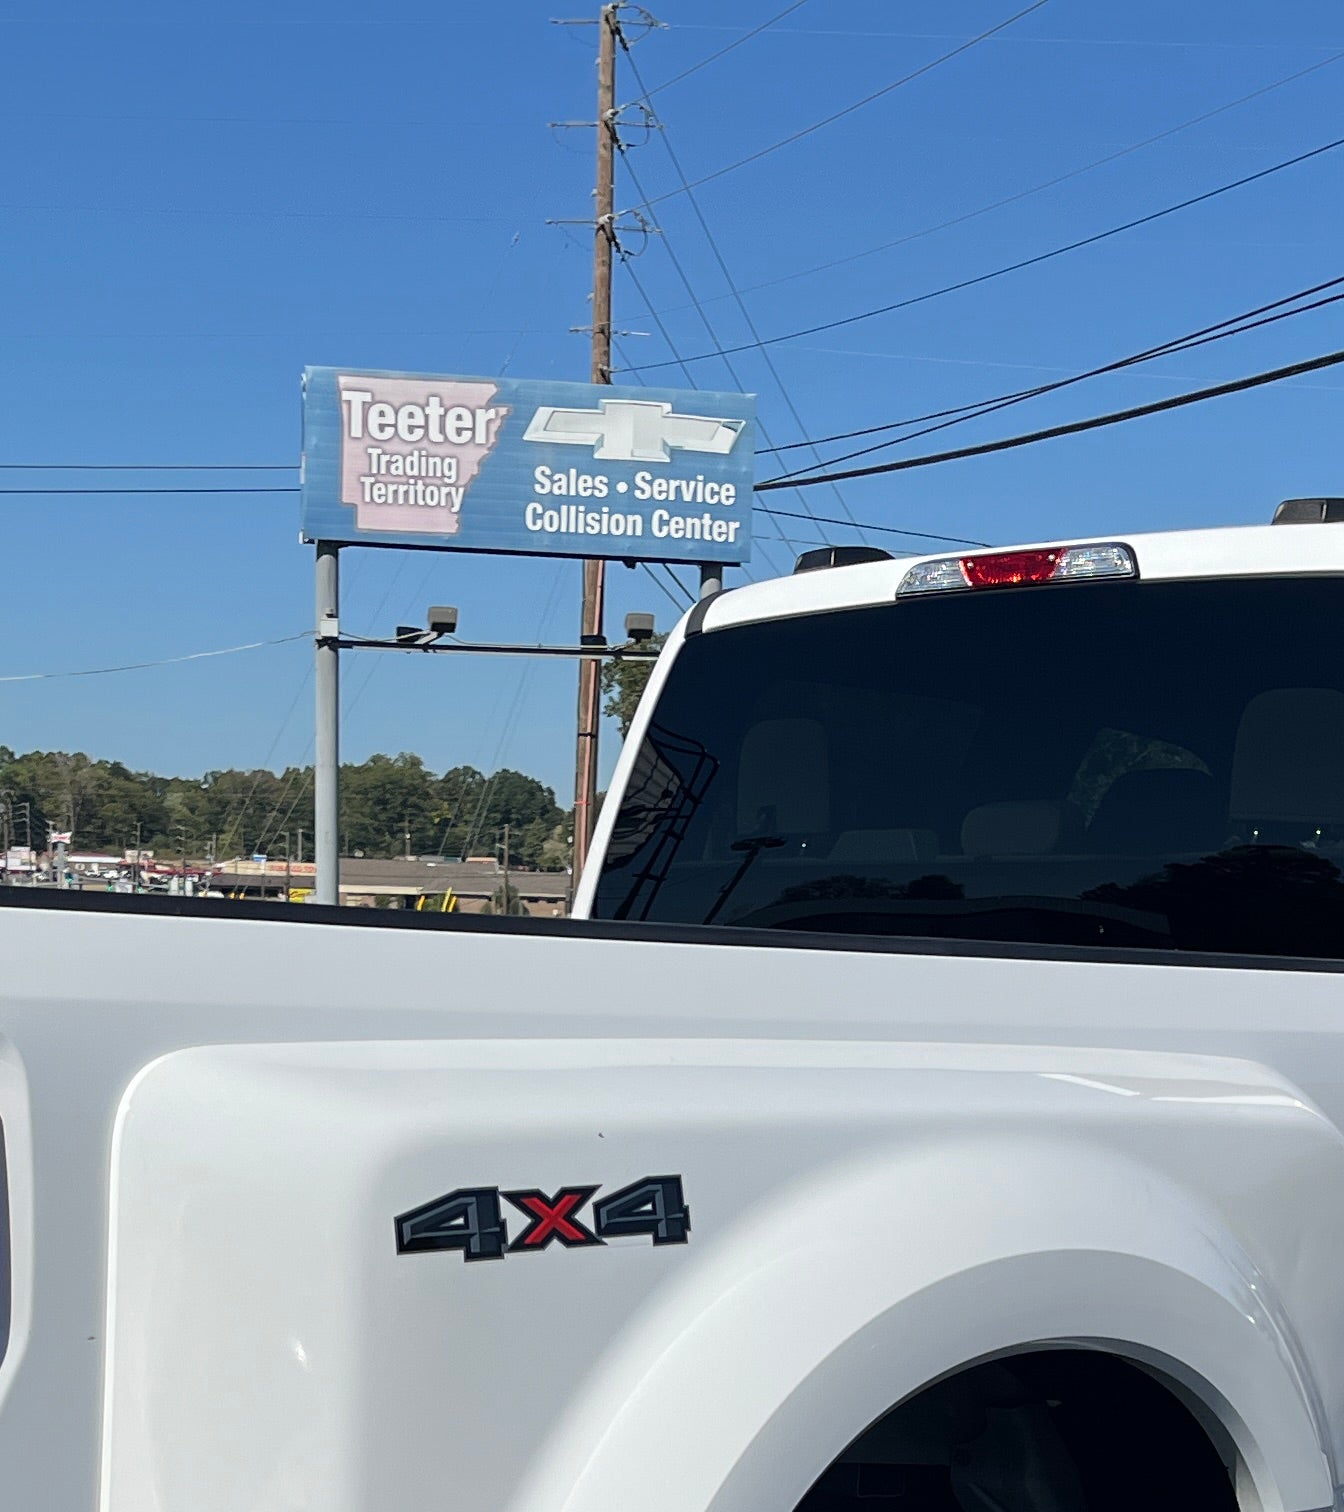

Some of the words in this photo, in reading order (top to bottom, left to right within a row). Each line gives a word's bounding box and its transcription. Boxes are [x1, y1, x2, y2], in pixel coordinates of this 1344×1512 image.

[341, 390, 497, 446] Teeter
[367, 447, 457, 484] Trading
[533, 465, 609, 498] Sales
[633, 471, 737, 506] Service
[359, 475, 465, 512] Territory
[525, 502, 644, 538] Collision
[651, 508, 741, 544] Center
